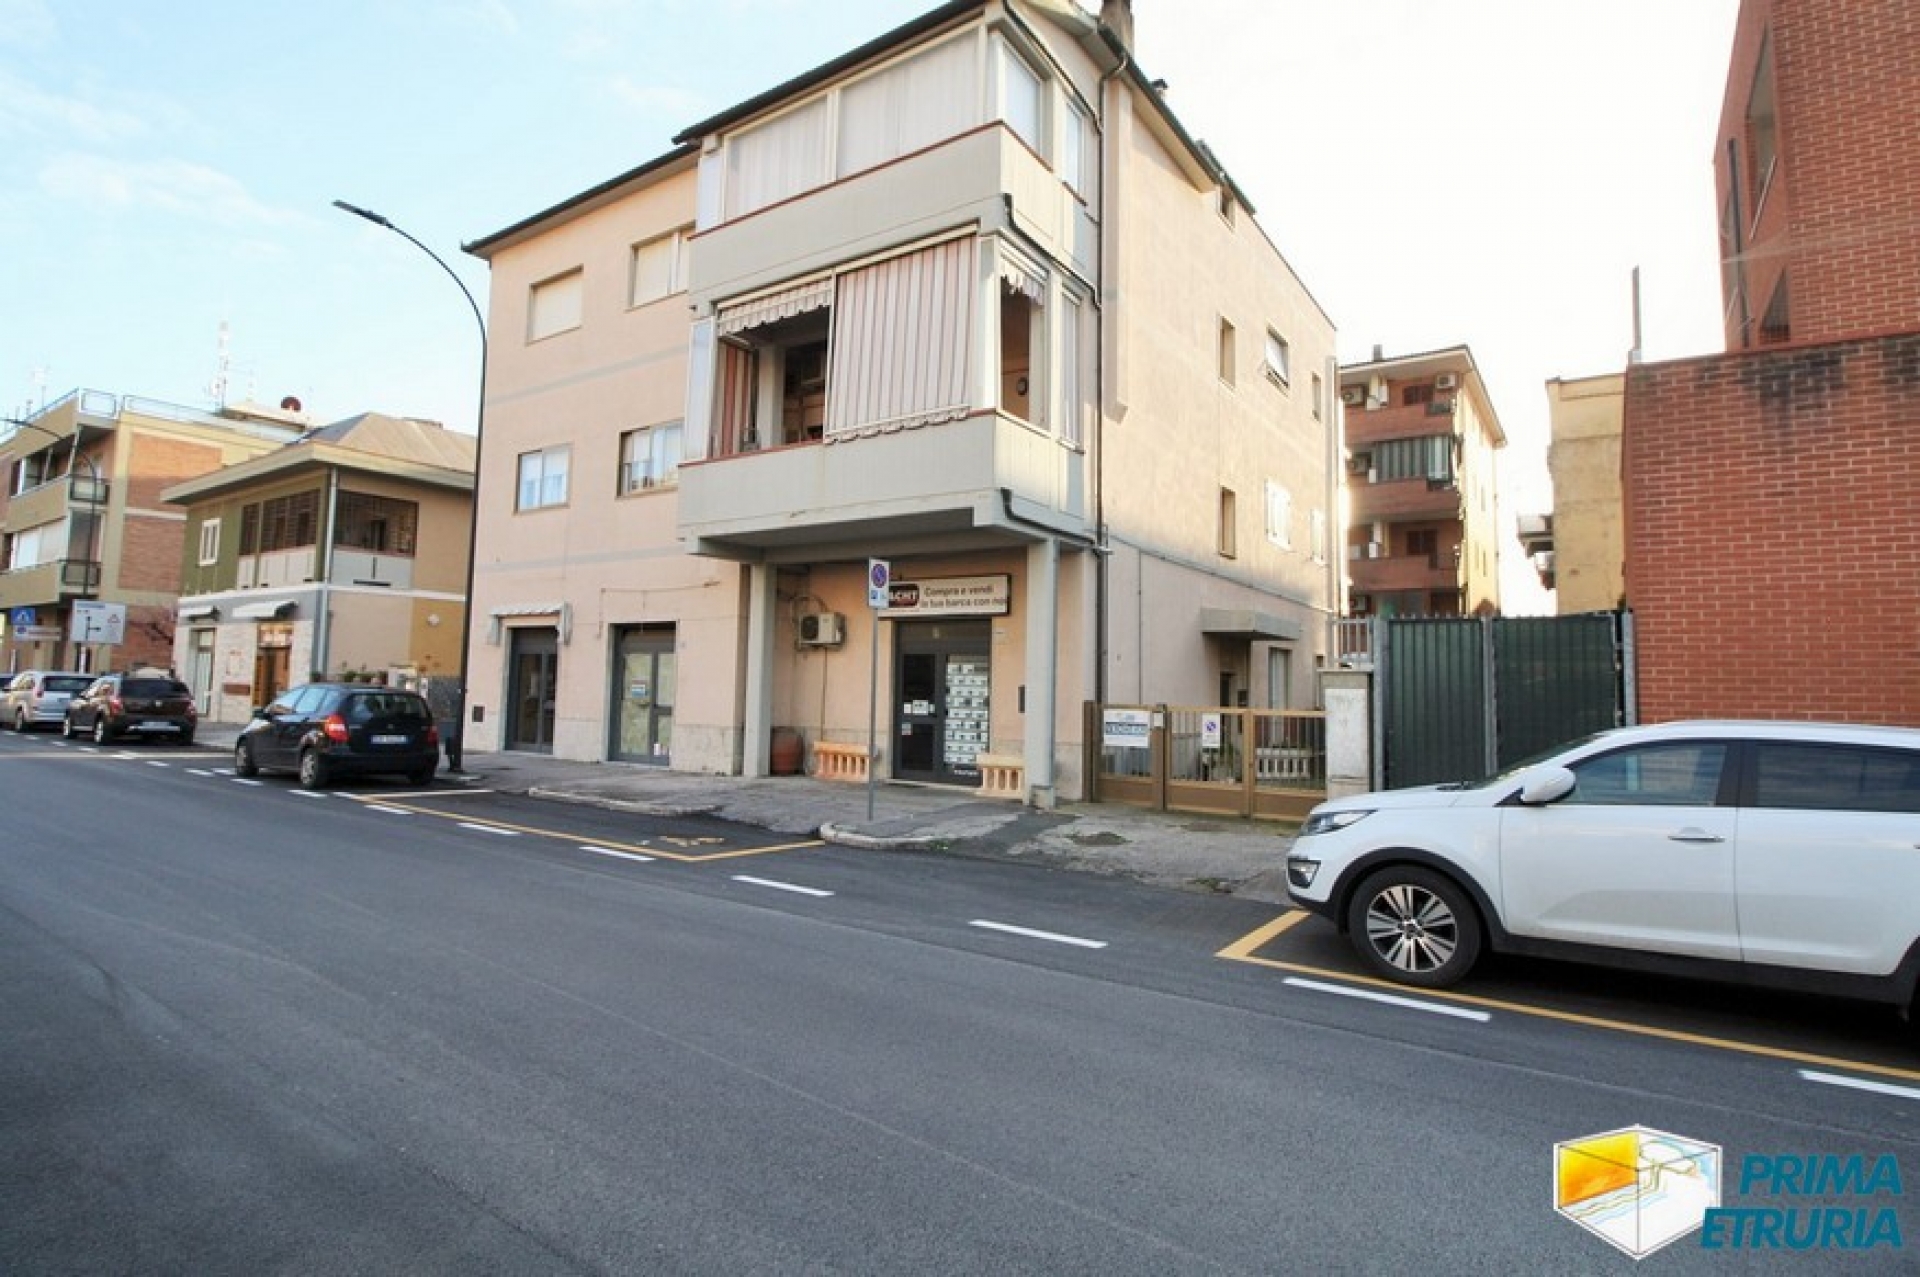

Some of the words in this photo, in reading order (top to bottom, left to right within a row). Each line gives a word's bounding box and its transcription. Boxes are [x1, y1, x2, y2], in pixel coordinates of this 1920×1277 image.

[924, 587, 959, 597] Compra
[969, 585, 994, 595] vendi
[930, 599, 944, 608] tua
[946, 598, 970, 608] barca
[974, 599, 990, 607] con
